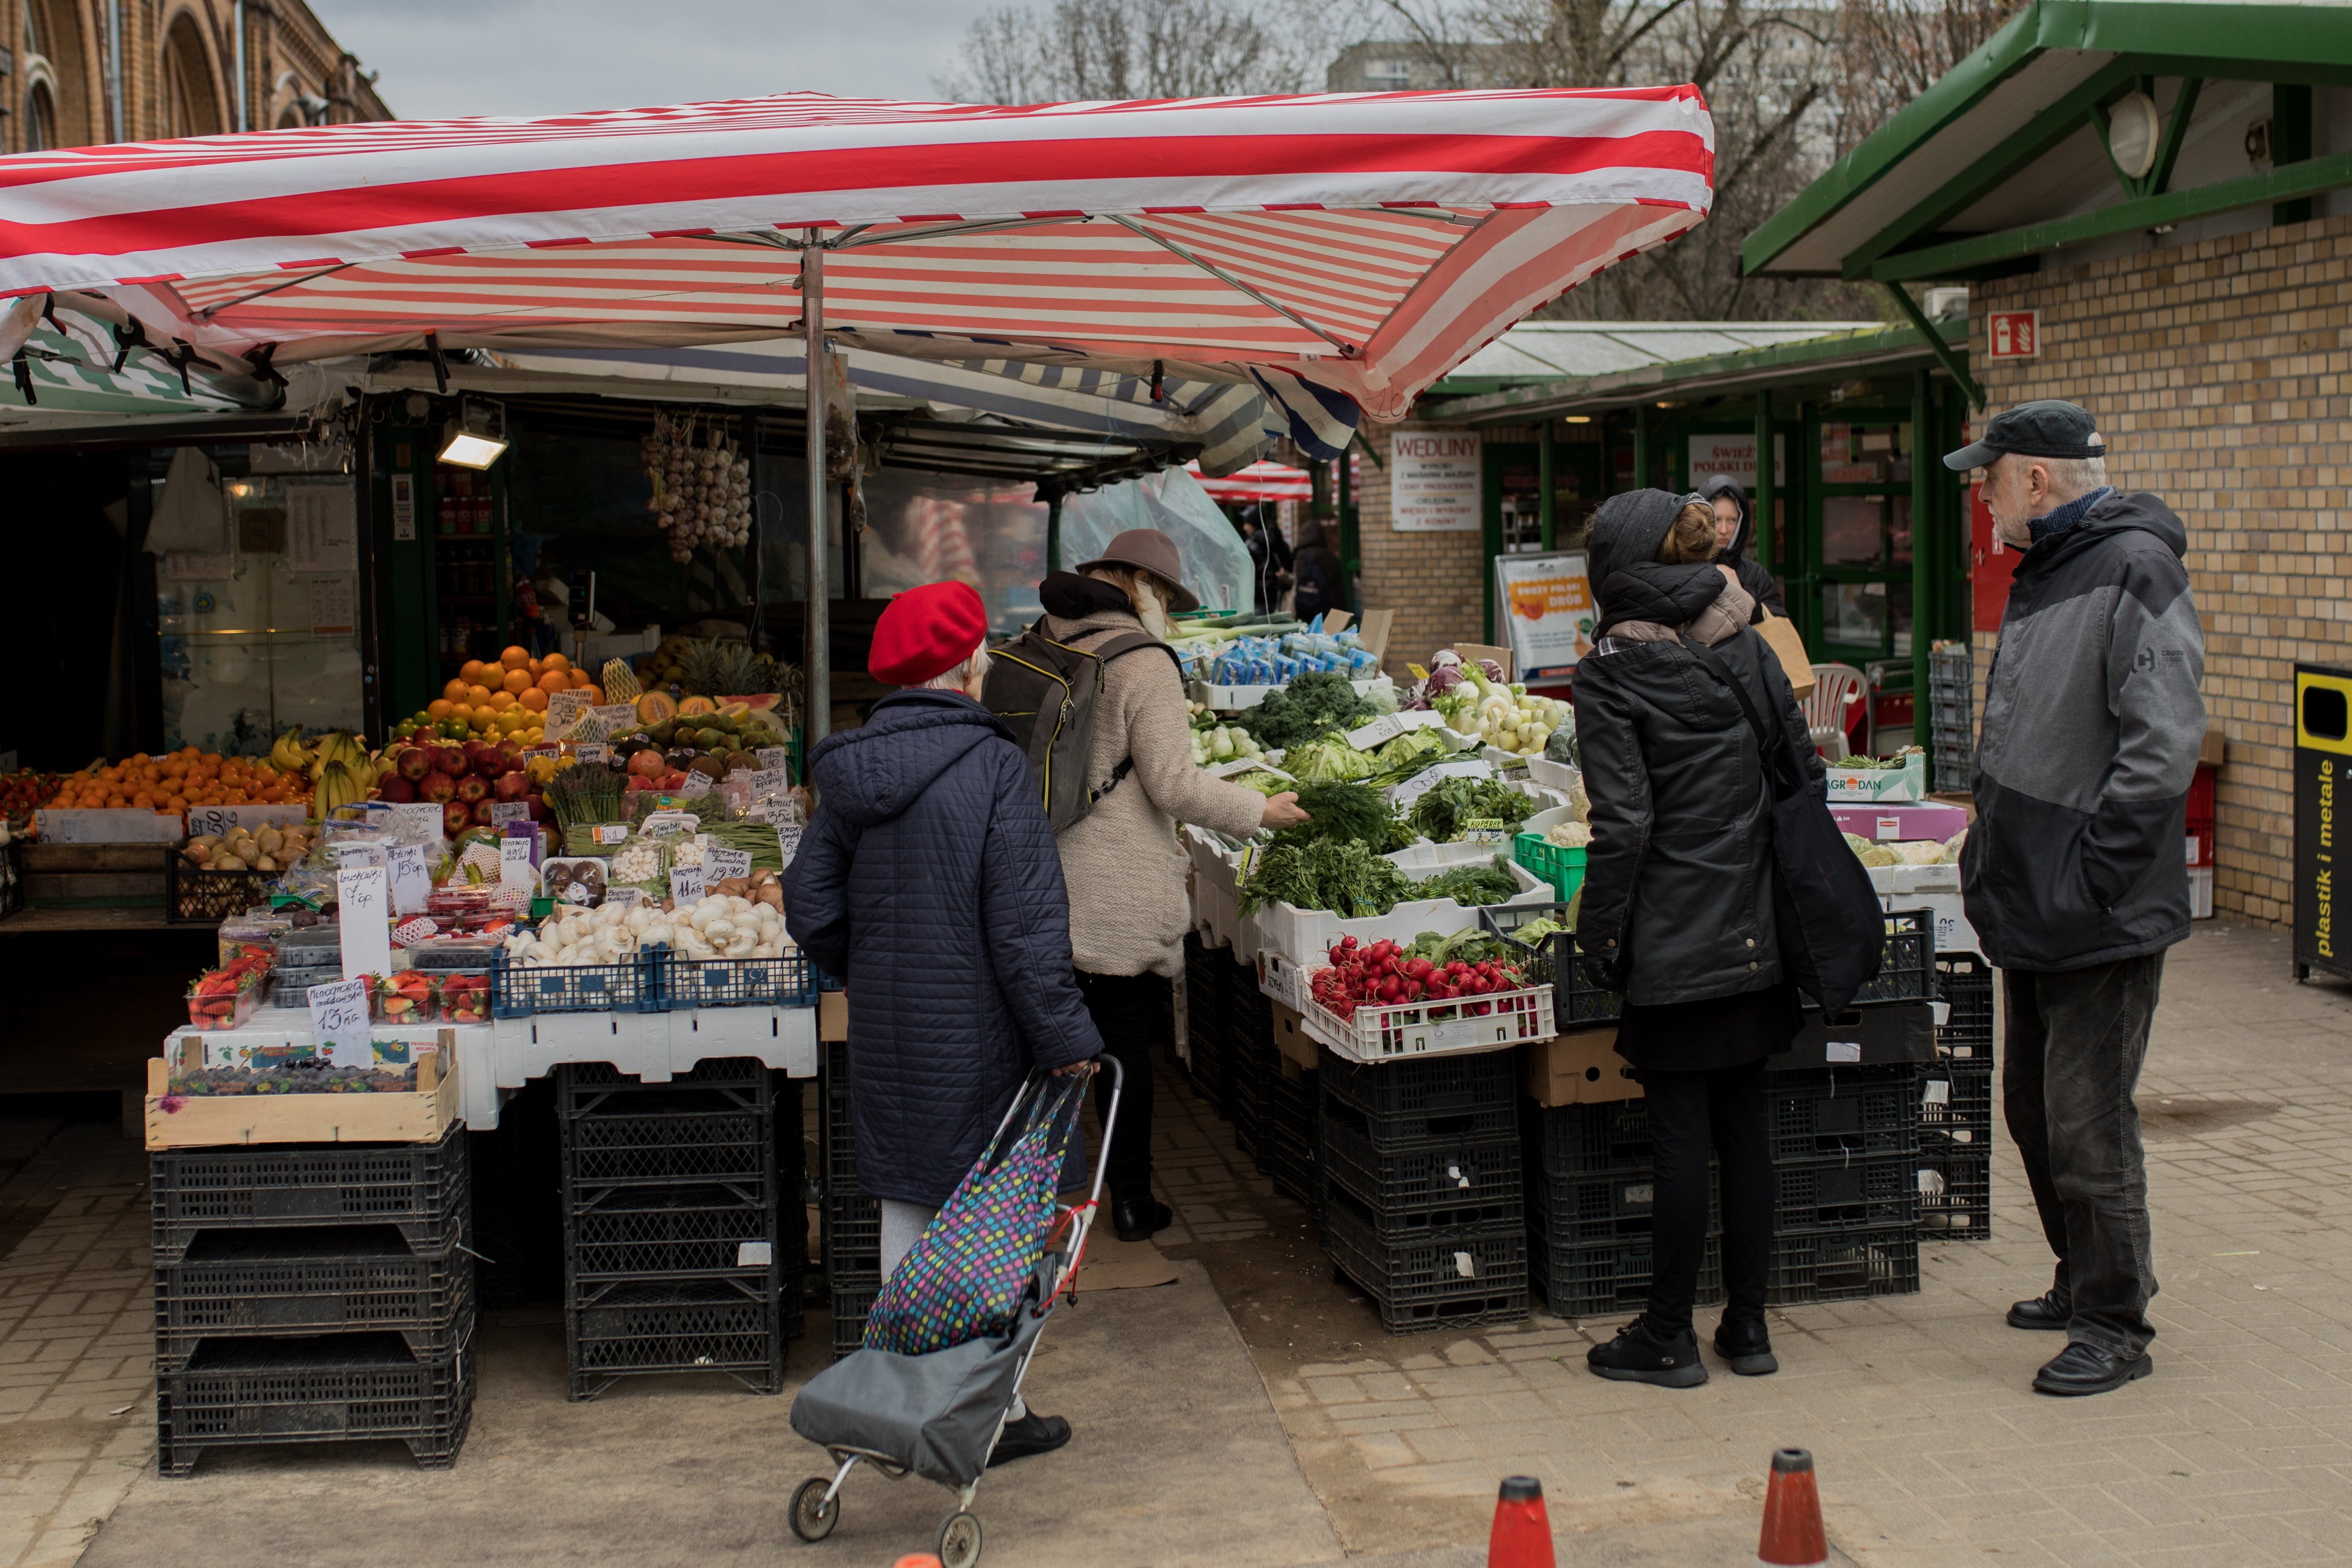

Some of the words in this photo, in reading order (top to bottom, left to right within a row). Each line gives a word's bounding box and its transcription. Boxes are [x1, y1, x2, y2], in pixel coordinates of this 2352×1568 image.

[1395, 437, 1478, 458] WĘDLINY
[1711, 443, 1756, 459] ŚWIEŻ
[1693, 460, 1740, 471] POLSKI
[1550, 583, 1581, 593] POLSKI
[1549, 593, 1583, 607] DRÓB
[2318, 759, 2334, 848] metale
[2318, 852, 2332, 862] i
[2315, 867, 2333, 958] plastik
